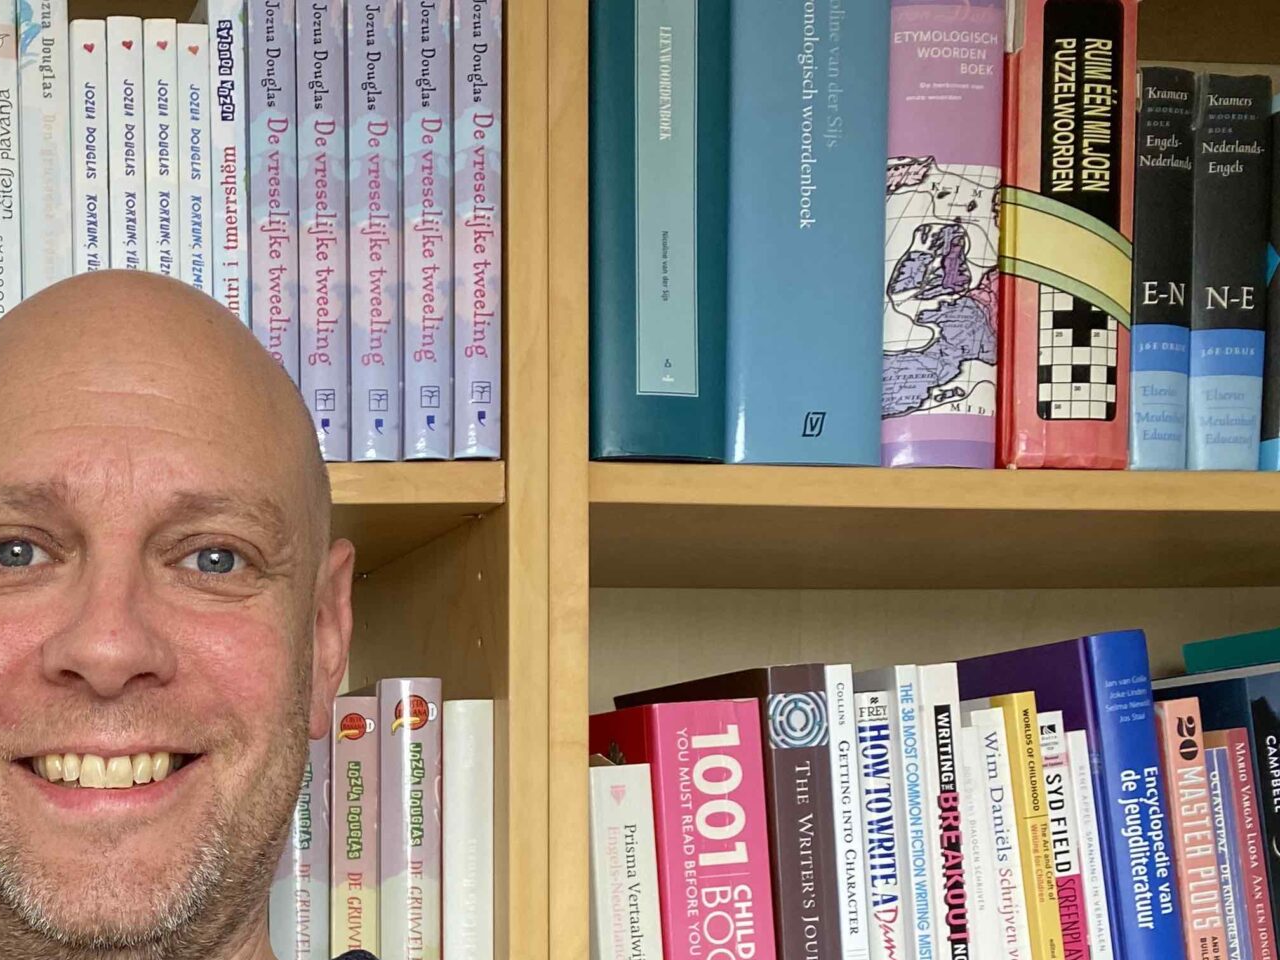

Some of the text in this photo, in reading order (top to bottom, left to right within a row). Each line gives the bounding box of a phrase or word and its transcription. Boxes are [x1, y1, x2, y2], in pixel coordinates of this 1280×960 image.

[217, 20, 235, 120] JOZUA DOUGLAS
[361, 3, 382, 111] Jozua Douglas
[894, 31, 998, 45] ETYMOLOGISCH
[917, 47, 986, 60] WOORDEN
[960, 63, 994, 75] BOEK
[1052, 38, 1077, 193] PUZZELWOORDEN
[1081, 38, 1118, 193] RUIM ÉÉN MILJOEN
[1145, 86, 1188, 101] Kramers
[1207, 94, 1253, 107] Kramers
[799, 105, 817, 229] woordenboek
[1139, 155, 1192, 171] Nederlands
[1146, 135, 1183, 151] Engels-
[1201, 140, 1265, 154] Nederlands-
[1208, 161, 1244, 176] Engels
[220, 145, 238, 251] tmerrshëm
[360, 120, 391, 366] De vreselijke tweeling
[1142, 281, 1186, 306] E-N
[1205, 286, 1255, 310] N-E
[858, 705, 888, 718] FREY
[935, 711, 955, 783] WRITING
[794, 761, 810, 805] THE
[857, 723, 891, 778] HOW
[984, 731, 1001, 780] Wim
[1022, 708, 1040, 811] WORLDS OF CHILDHOOD
[1266, 735, 1280, 813] CAMPBELL
[347, 761, 364, 891] JOZUA DOUGLAS DE
[691, 724, 749, 867] 1001
[864, 782, 893, 813] TO
[990, 787, 1012, 861] Daniëls
[1046, 774, 1064, 811] SYD
[1176, 716, 1222, 930] 20 MASTER PLOTS
[1235, 742, 1258, 869] MARIO VARGAS LLOSA
[623, 823, 638, 877] Prisma
[798, 814, 816, 908] WRITER'S
[838, 739, 859, 935] GETTING INTO CHARACTER
[867, 814, 898, 890] WRITE
[937, 792, 971, 943] BREAKOUT
[1050, 817, 1072, 873] FIELD
[1118, 769, 1155, 930] de jeugdliteratuur
[1143, 766, 1173, 914] Encyclopedie van
[872, 891, 899, 908] A
[998, 869, 1019, 945] Schrijven
